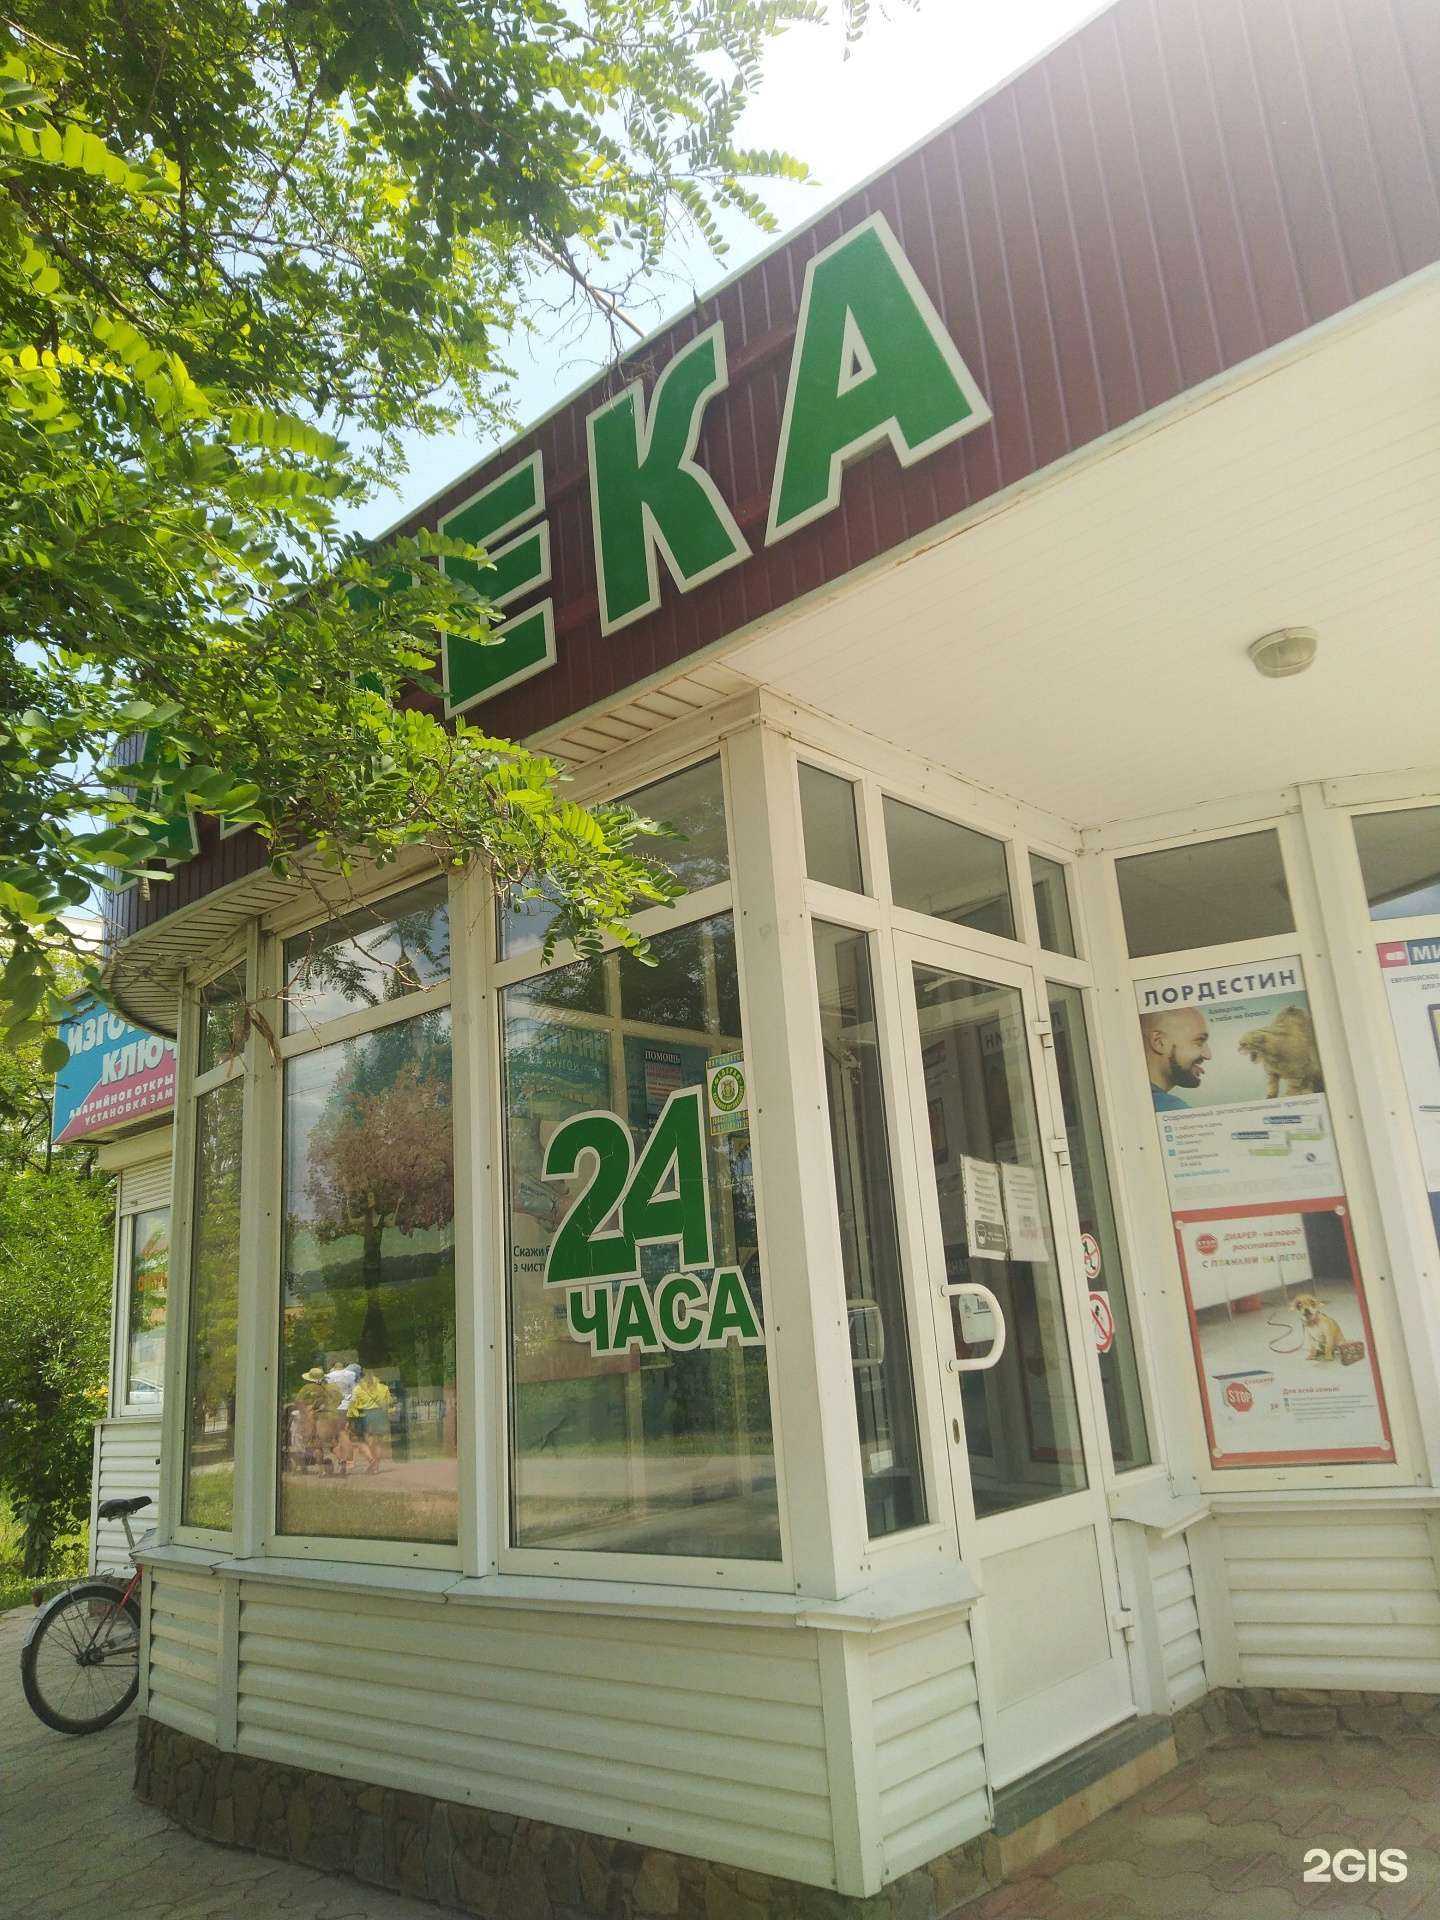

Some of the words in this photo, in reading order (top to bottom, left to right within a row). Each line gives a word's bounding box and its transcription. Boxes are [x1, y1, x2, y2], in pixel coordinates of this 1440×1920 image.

[344, 209, 993, 720] ЕКА
[1143, 968, 1297, 1008] ЛОРДЕСТИН
[67, 1012, 135, 1057] ИЗГО
[68, 1088, 132, 1120] АВАРИЙНОЕ
[134, 1073, 175, 1097] ОТКРЫ
[84, 1097, 148, 1127] УСТАНОВКА
[149, 1088, 174, 1105] ЗАМ
[540, 1083, 715, 1289] 24
[513, 1245, 545, 1258] Скажи
[565, 1265, 765, 1357] ЧАСА
[1227, 1389, 1253, 1404] STOP
